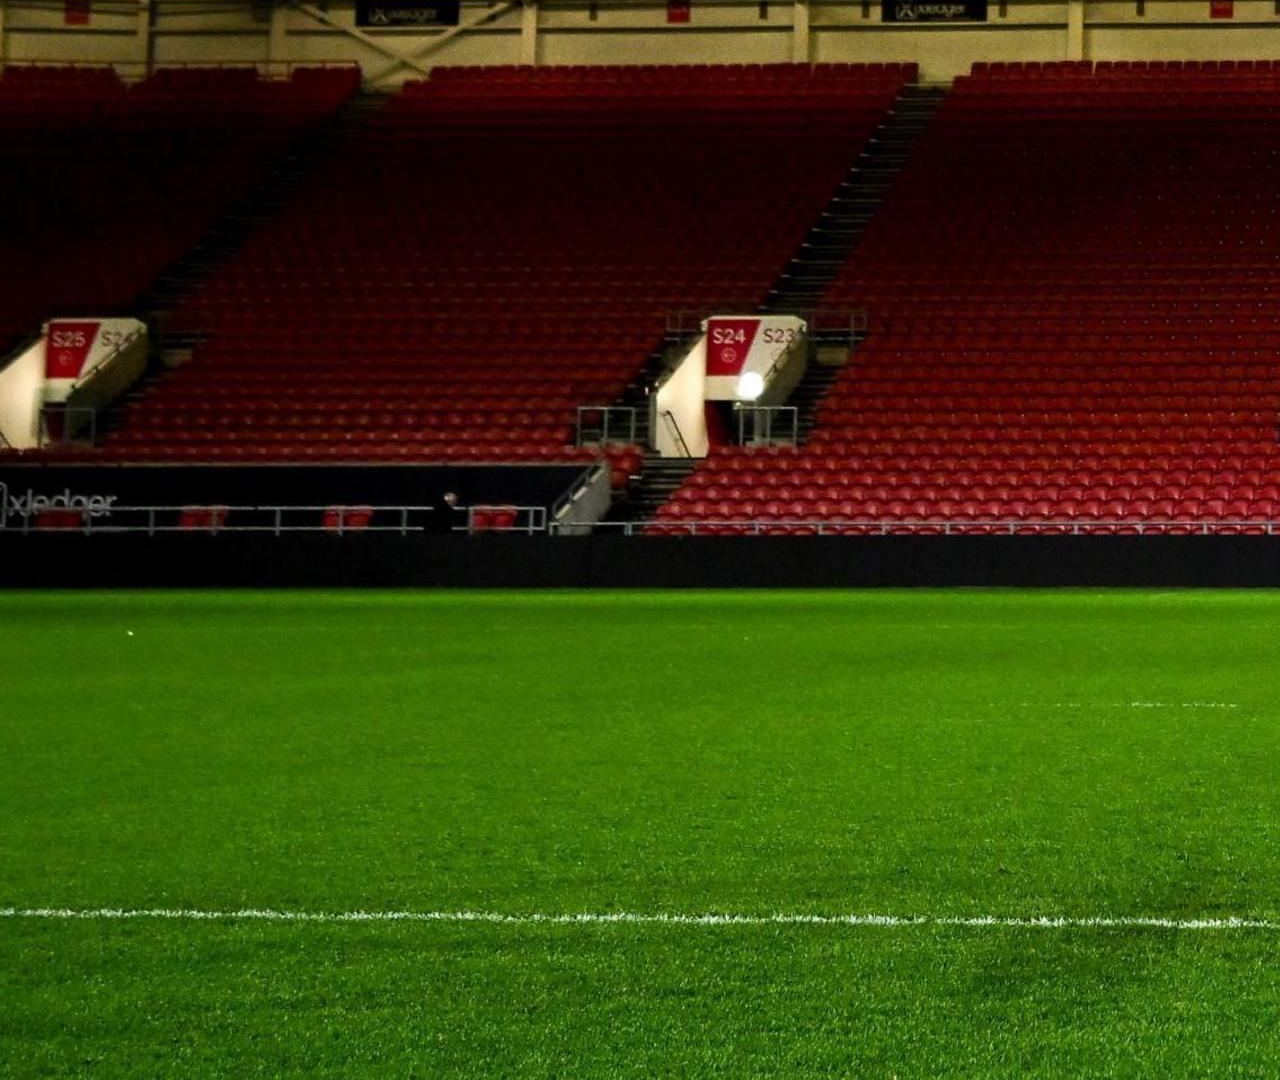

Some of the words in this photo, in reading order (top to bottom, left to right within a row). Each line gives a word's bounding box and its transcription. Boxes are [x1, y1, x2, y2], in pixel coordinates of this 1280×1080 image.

[52, 330, 87, 348] S25
[713, 327, 746, 344] S24
[764, 328, 795, 344] S23
